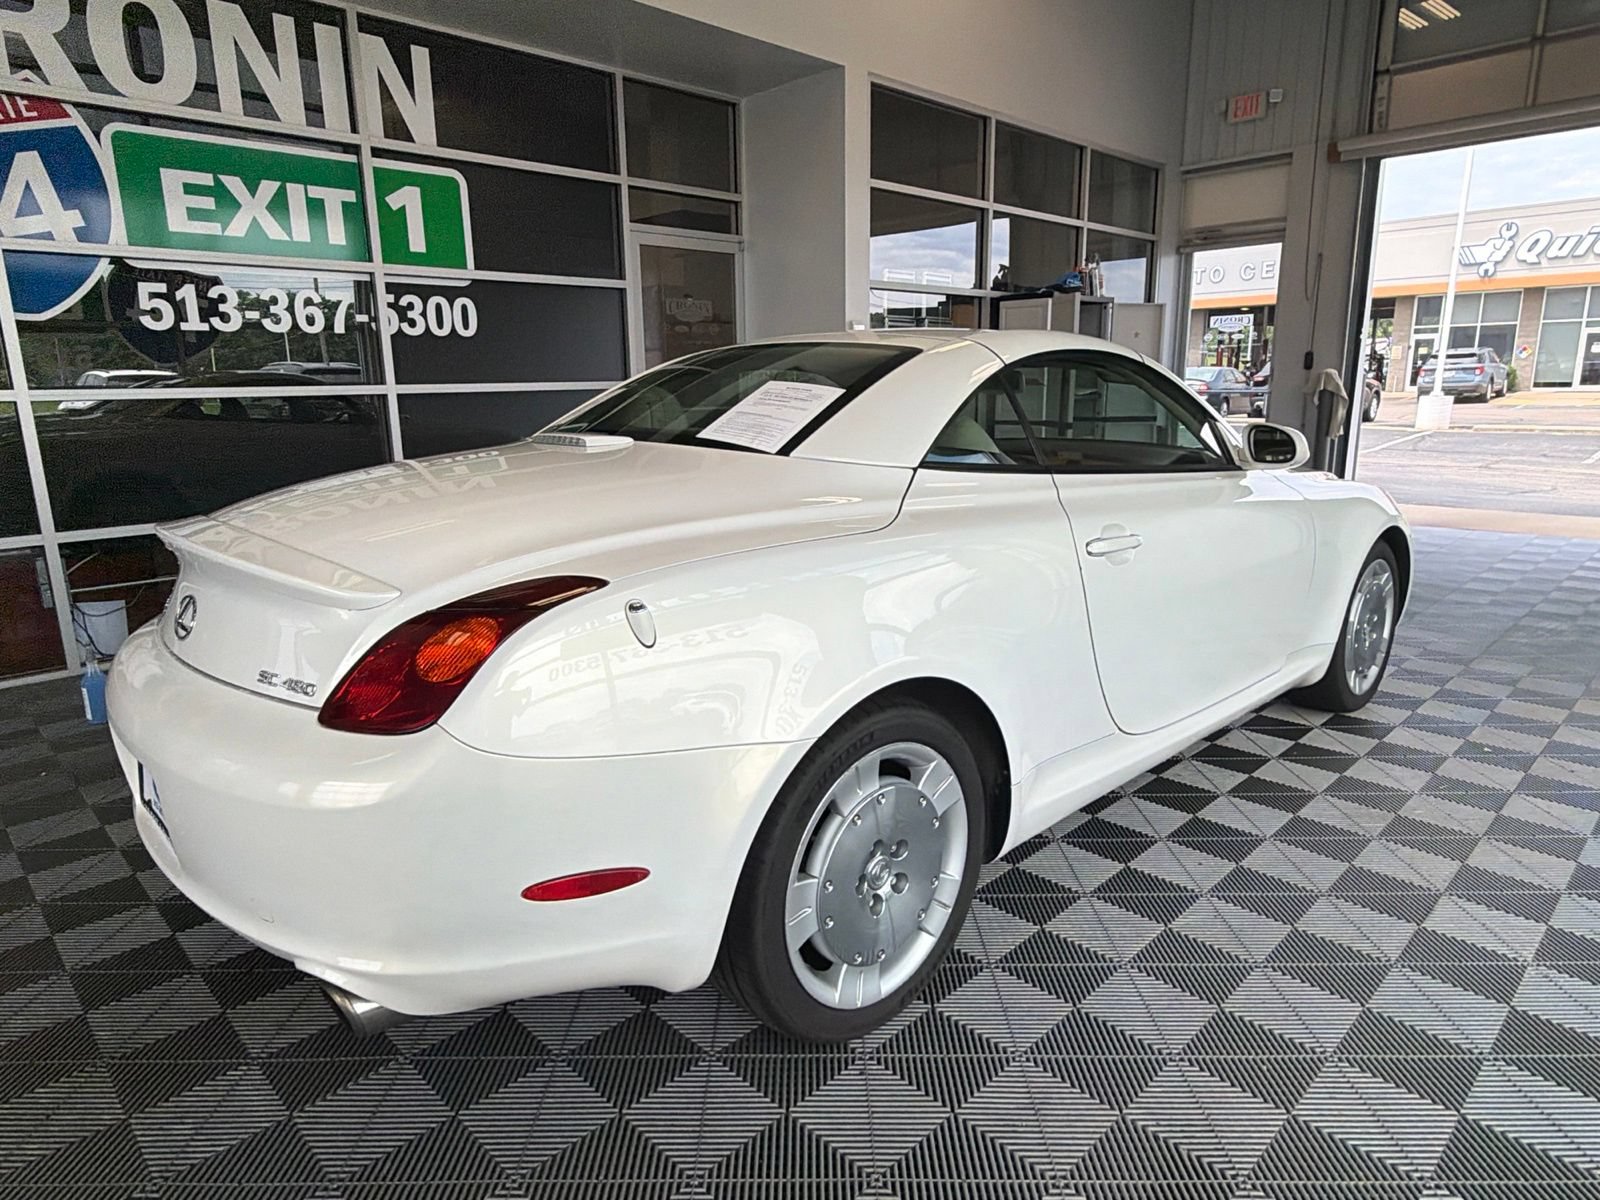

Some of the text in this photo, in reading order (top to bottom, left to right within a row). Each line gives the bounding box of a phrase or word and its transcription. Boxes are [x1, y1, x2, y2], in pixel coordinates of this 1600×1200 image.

[1233, 95, 1261, 119] EXIT
[0, 150, 86, 242] 4
[159, 167, 427, 254] EXIT 1
[1193, 260, 1276, 285] TO CE
[137, 281, 478, 338] 513-367-5300
[256, 669, 281, 688] SC
